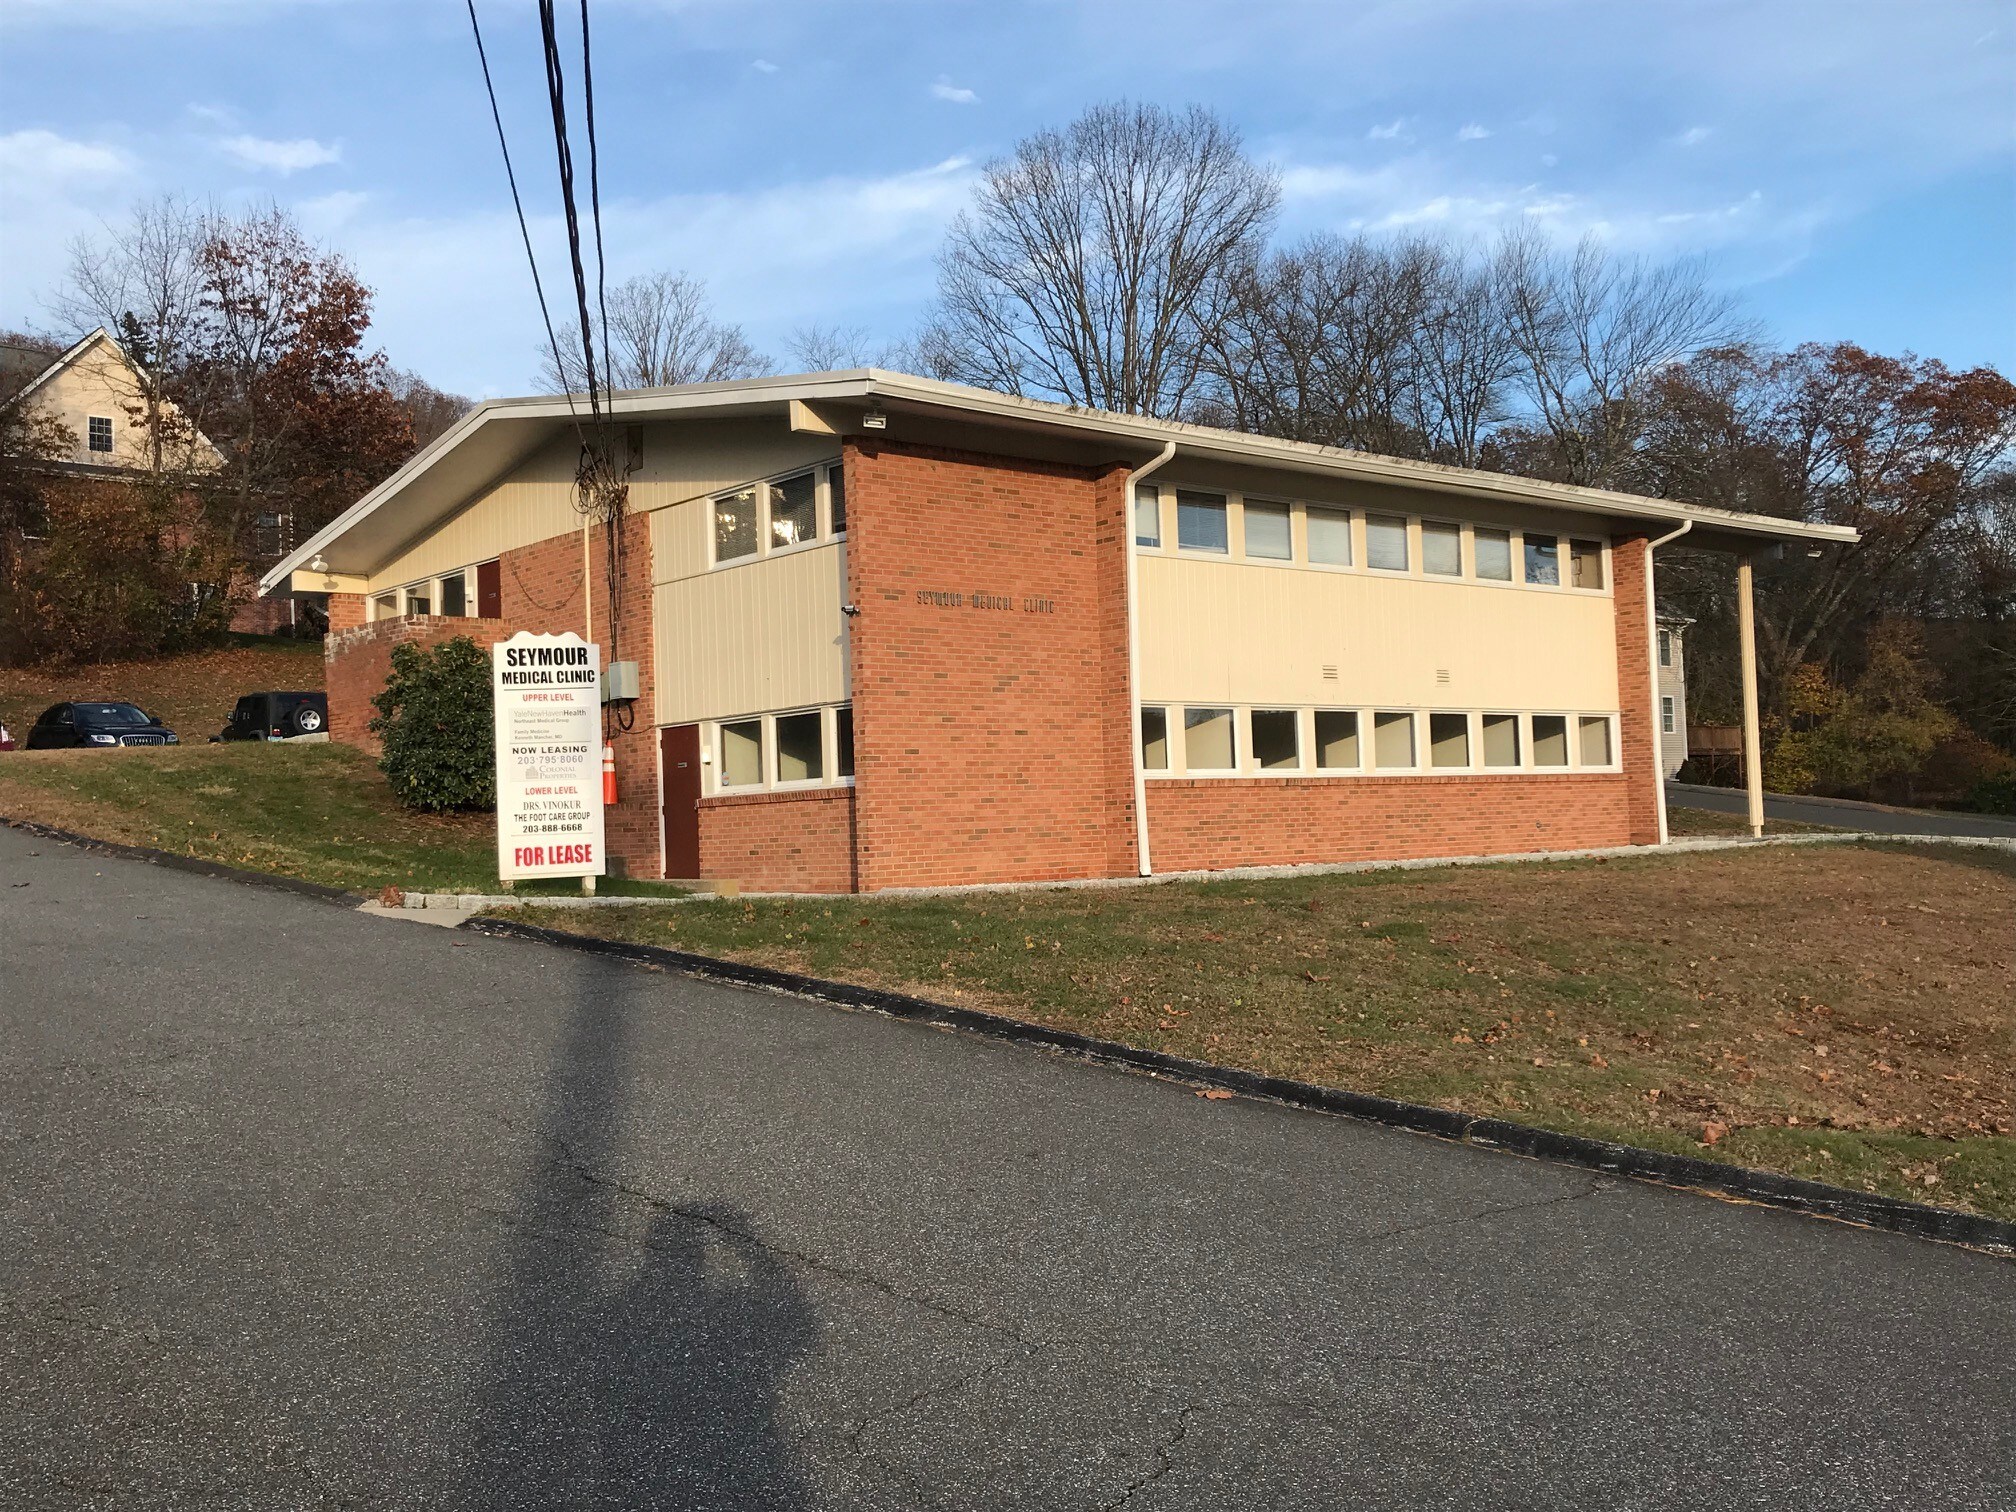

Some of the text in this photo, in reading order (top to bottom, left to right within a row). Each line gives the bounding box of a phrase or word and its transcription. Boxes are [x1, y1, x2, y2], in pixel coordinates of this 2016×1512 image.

[916, 590, 1054, 613] SEYMOUR MEDICAL CLINIC
[507, 647, 588, 666] SEYMOUR
[502, 670, 595, 684] MEDICAL CLINIC
[523, 801, 581, 810] DRS. VINOKUR
[549, 812, 566, 820] CARE
[568, 812, 590, 820] GROUP
[523, 824, 582, 833] 203-888-6668
[515, 844, 592, 867] FOR LEASE
